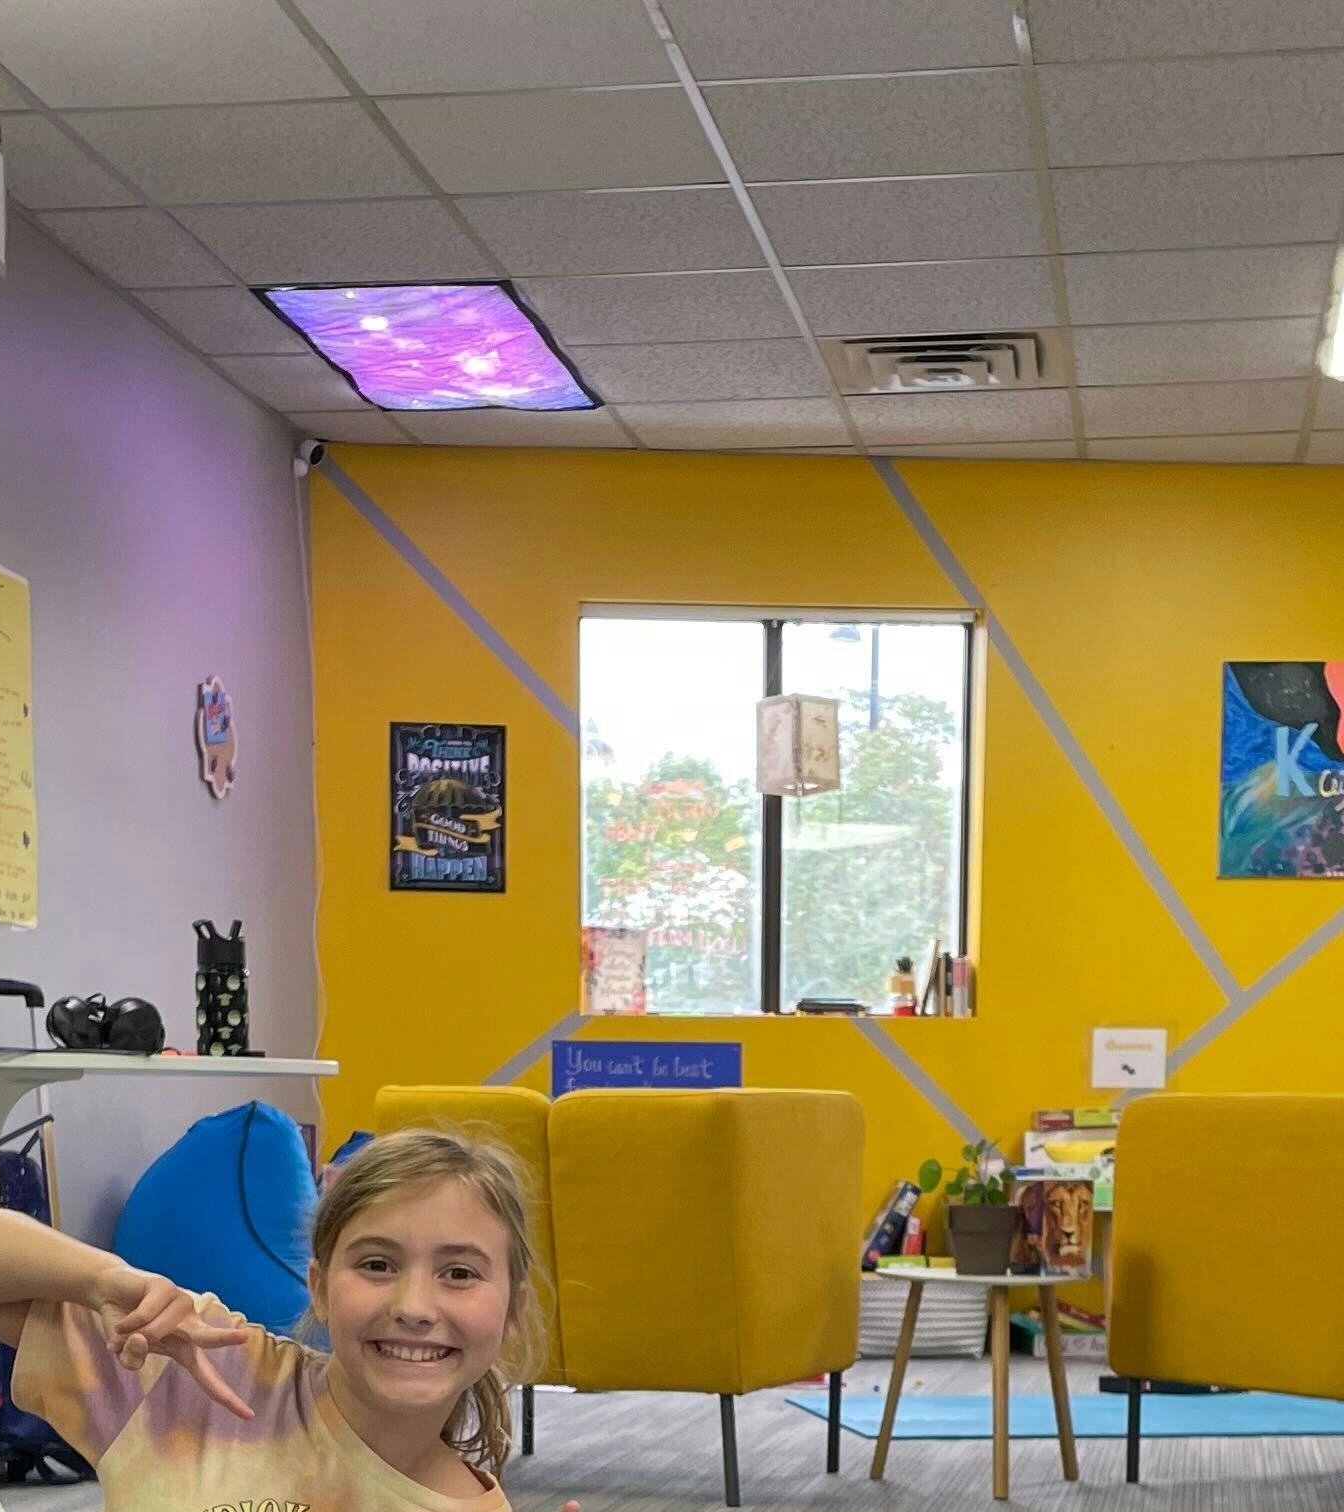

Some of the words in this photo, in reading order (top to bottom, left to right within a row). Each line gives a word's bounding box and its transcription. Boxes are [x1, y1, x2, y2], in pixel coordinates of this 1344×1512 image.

[407, 752, 491, 774] POSITIVE
[430, 813, 467, 835] GOOD
[411, 852, 488, 881] HAPPEN
[565, 1046, 602, 1076] You
